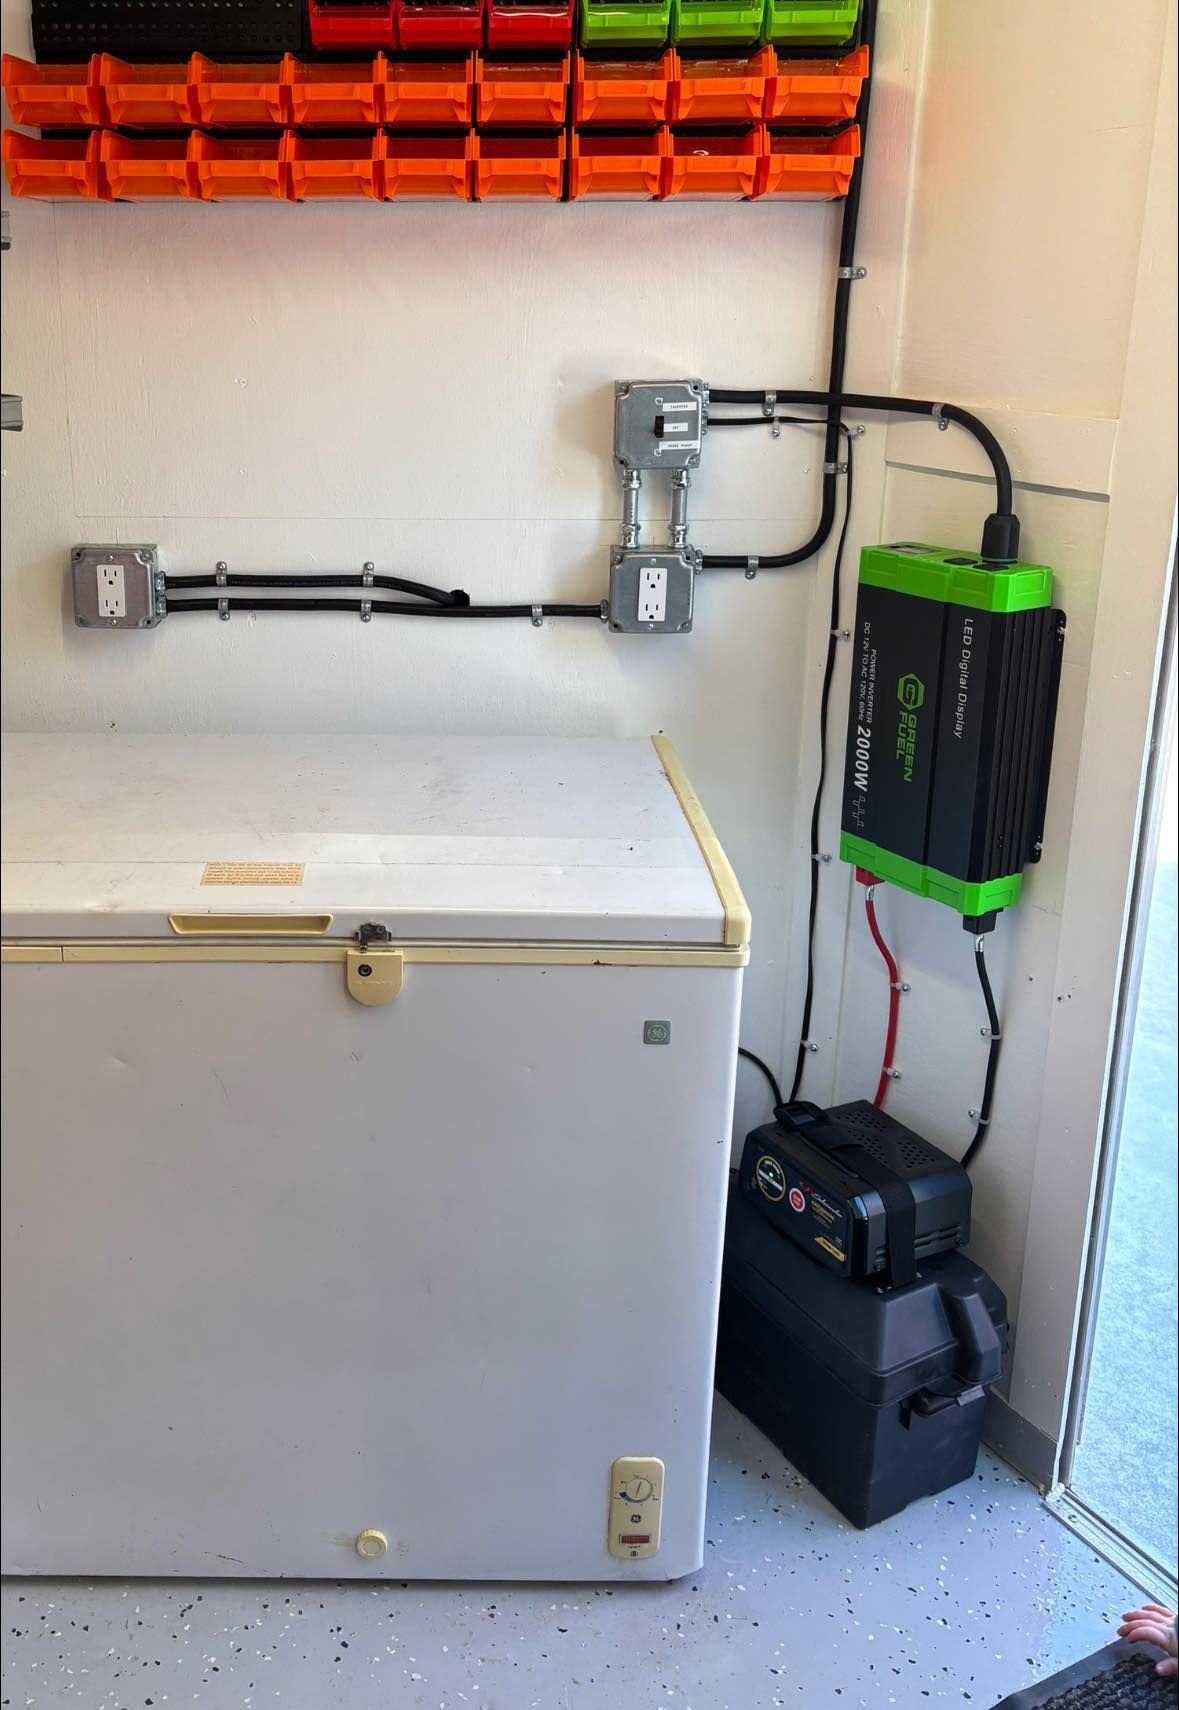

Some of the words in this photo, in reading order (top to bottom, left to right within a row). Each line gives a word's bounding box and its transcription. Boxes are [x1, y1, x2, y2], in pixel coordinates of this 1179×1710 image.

[864, 622, 871, 634] DC
[963, 618, 974, 645] LED
[861, 665, 868, 678] AC
[862, 653, 869, 665] TO
[869, 648, 877, 681] POWER
[958, 649, 971, 690] Digital
[866, 681, 875, 724] INVERTER
[953, 693, 967, 739] Display
[896, 711, 908, 760] FUEL
[903, 714, 918, 782] GREEN
[854, 725, 871, 792] 2000W
